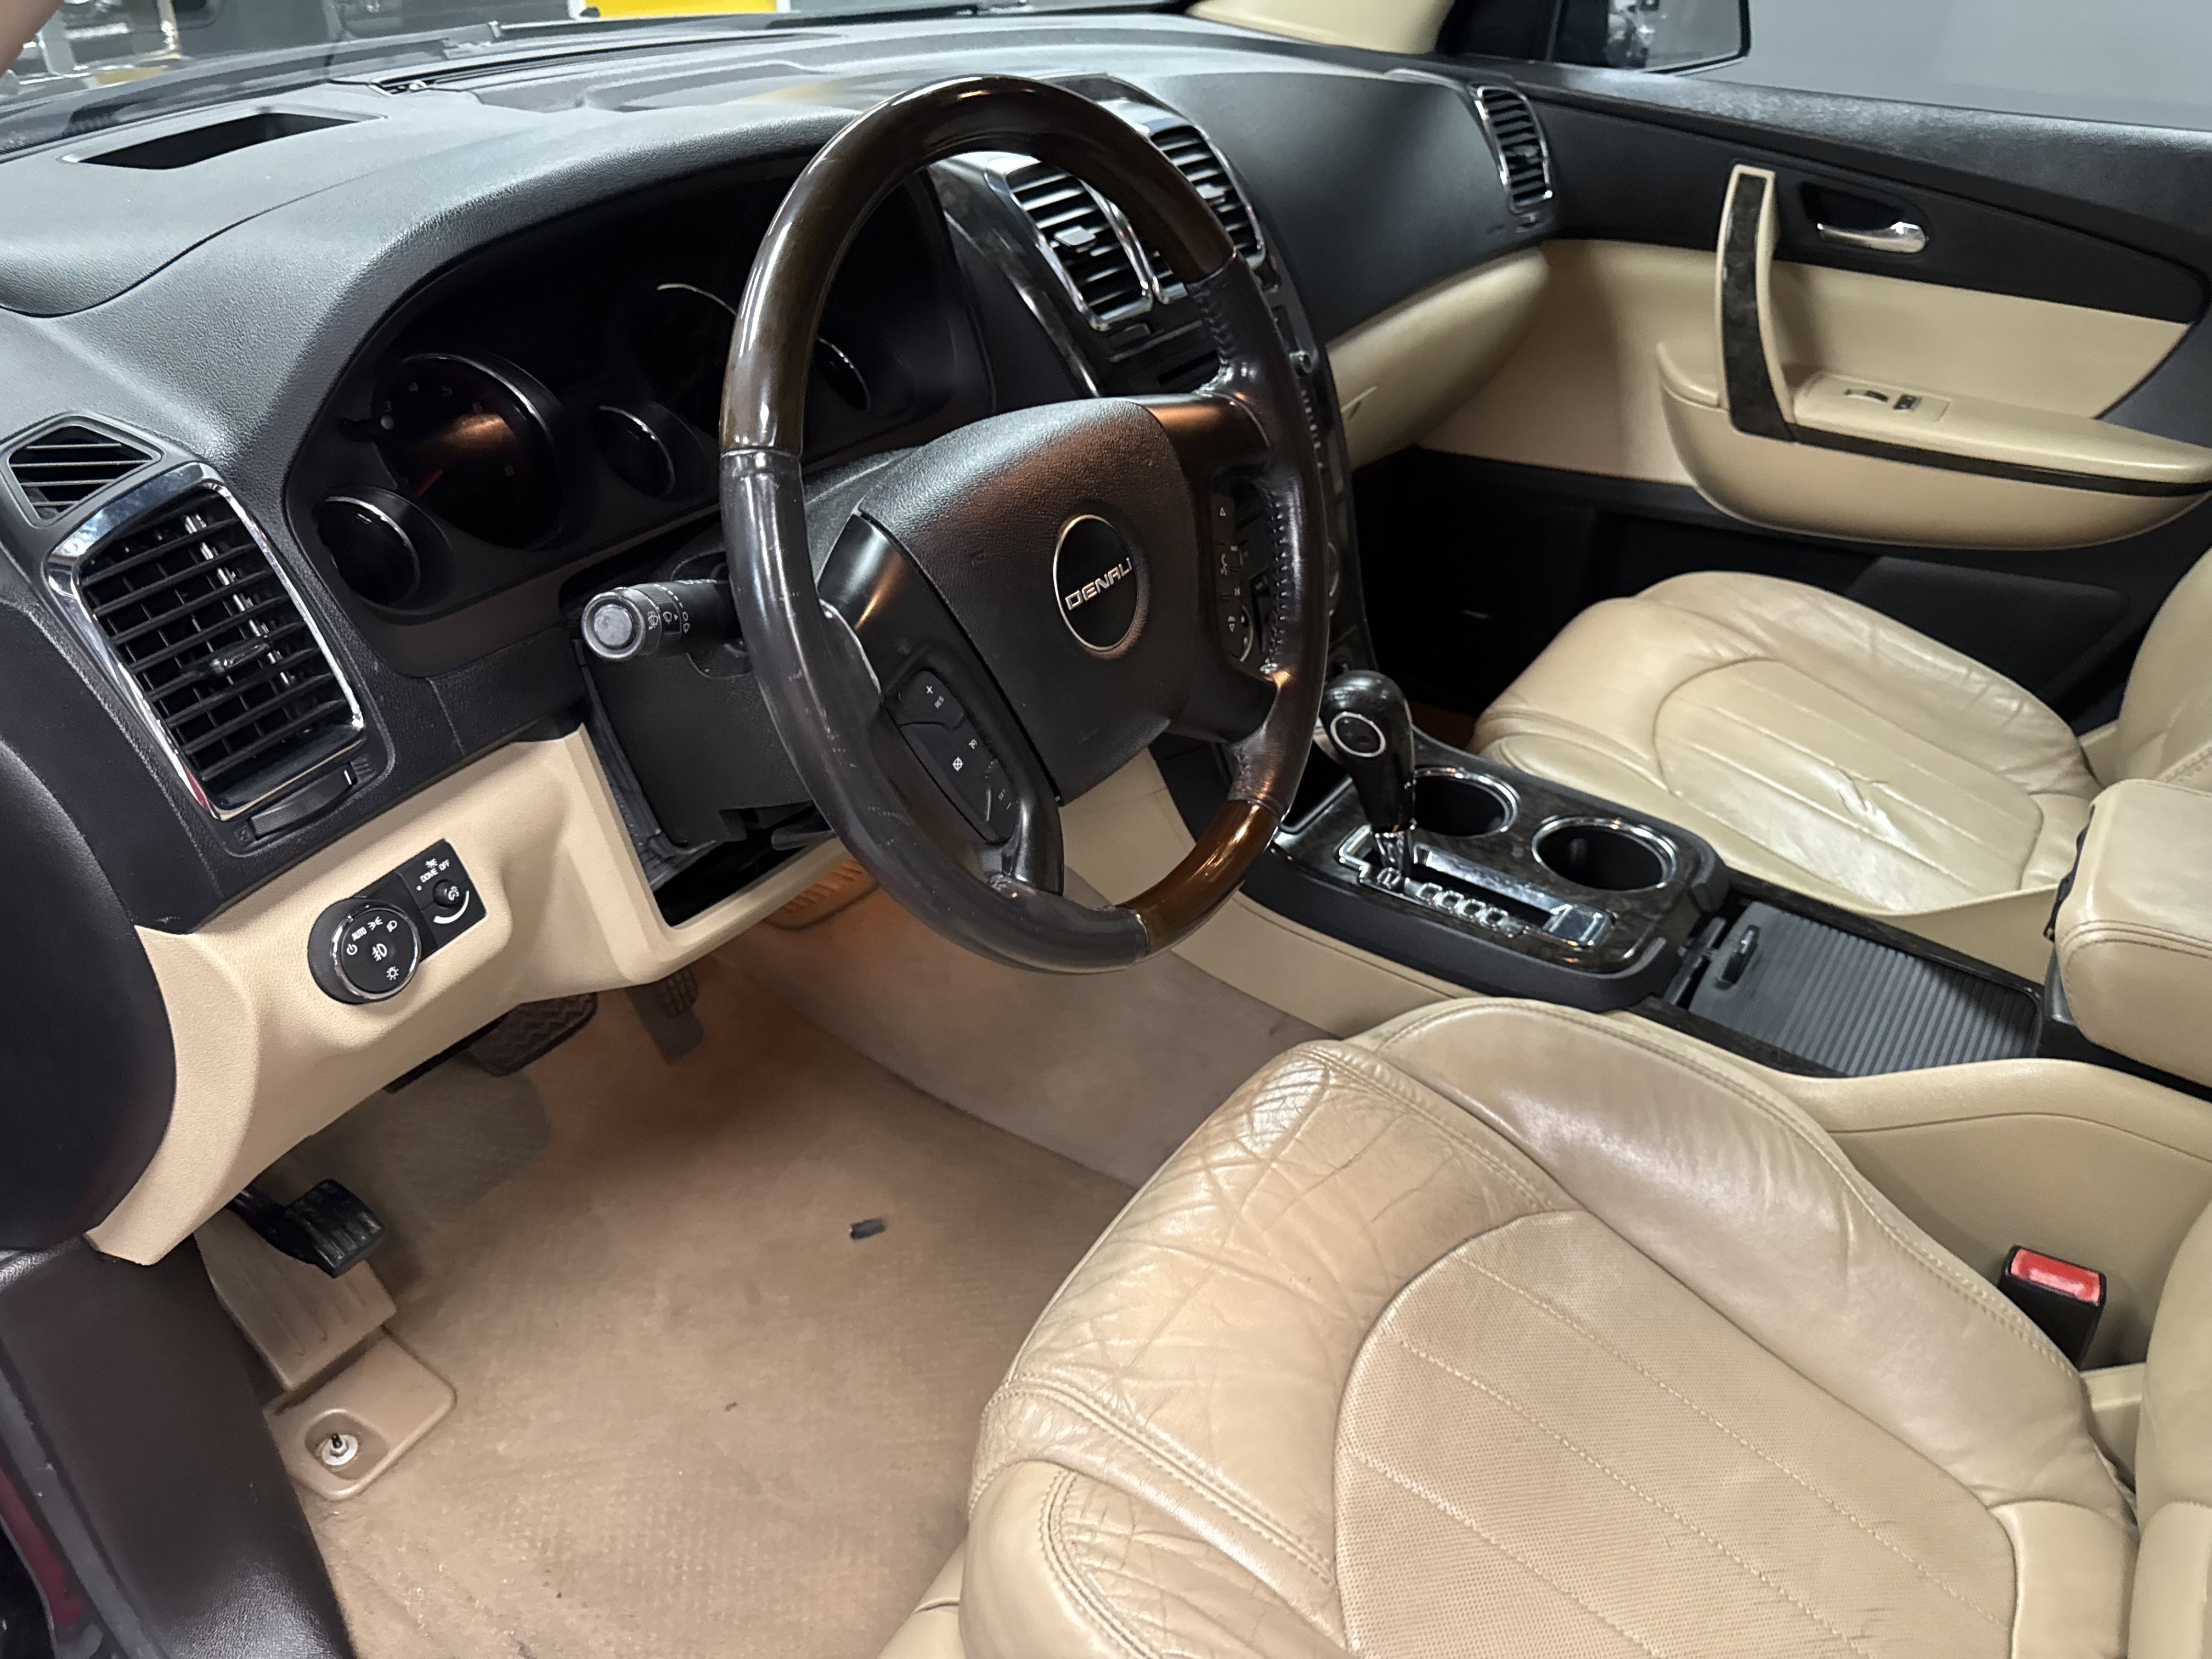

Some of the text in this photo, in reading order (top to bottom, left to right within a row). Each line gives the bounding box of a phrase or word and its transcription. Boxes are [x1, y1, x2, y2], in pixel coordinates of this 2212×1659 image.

[1065, 557, 1133, 611] DENALI
[420, 859, 450, 883] DOME OFF
[351, 927, 367, 941] AUTO
